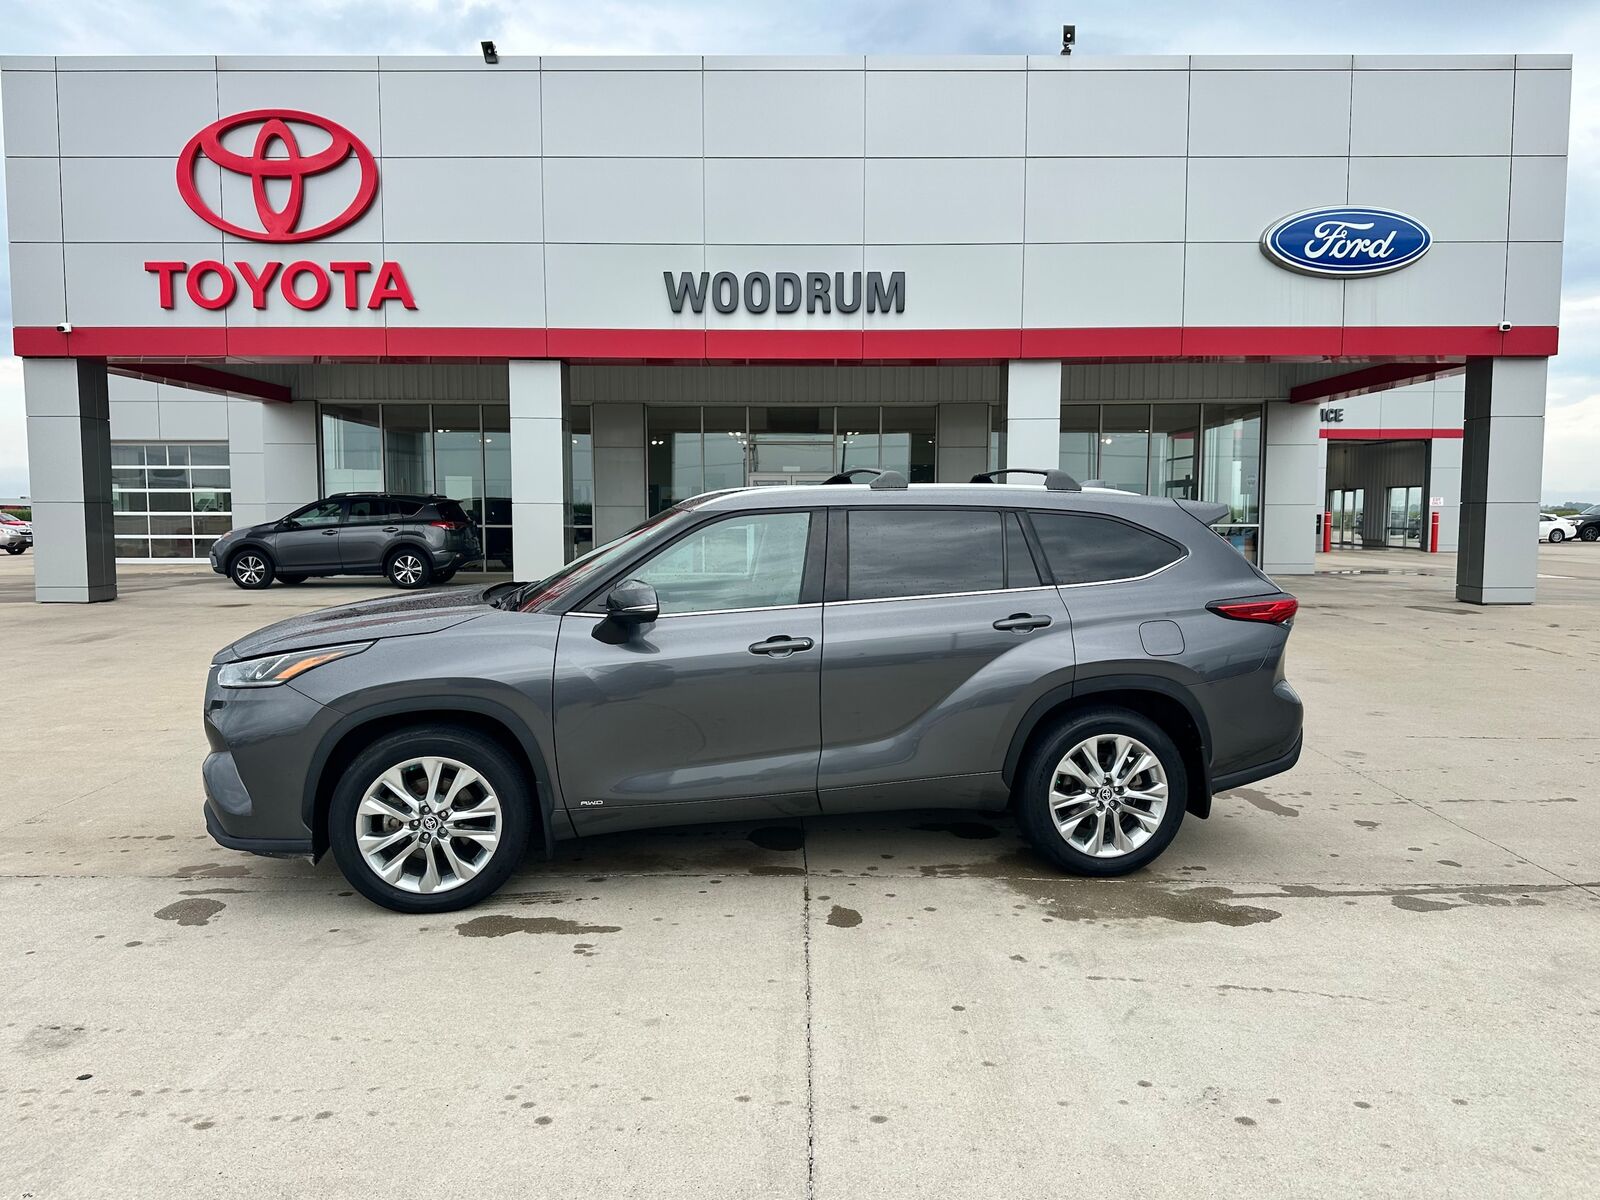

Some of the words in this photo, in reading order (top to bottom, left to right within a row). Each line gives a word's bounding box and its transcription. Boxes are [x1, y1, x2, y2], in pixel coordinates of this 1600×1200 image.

[1304, 220, 1398, 259] Ford
[144, 260, 419, 311] TOYOTA
[663, 271, 906, 314] WOODRUM
